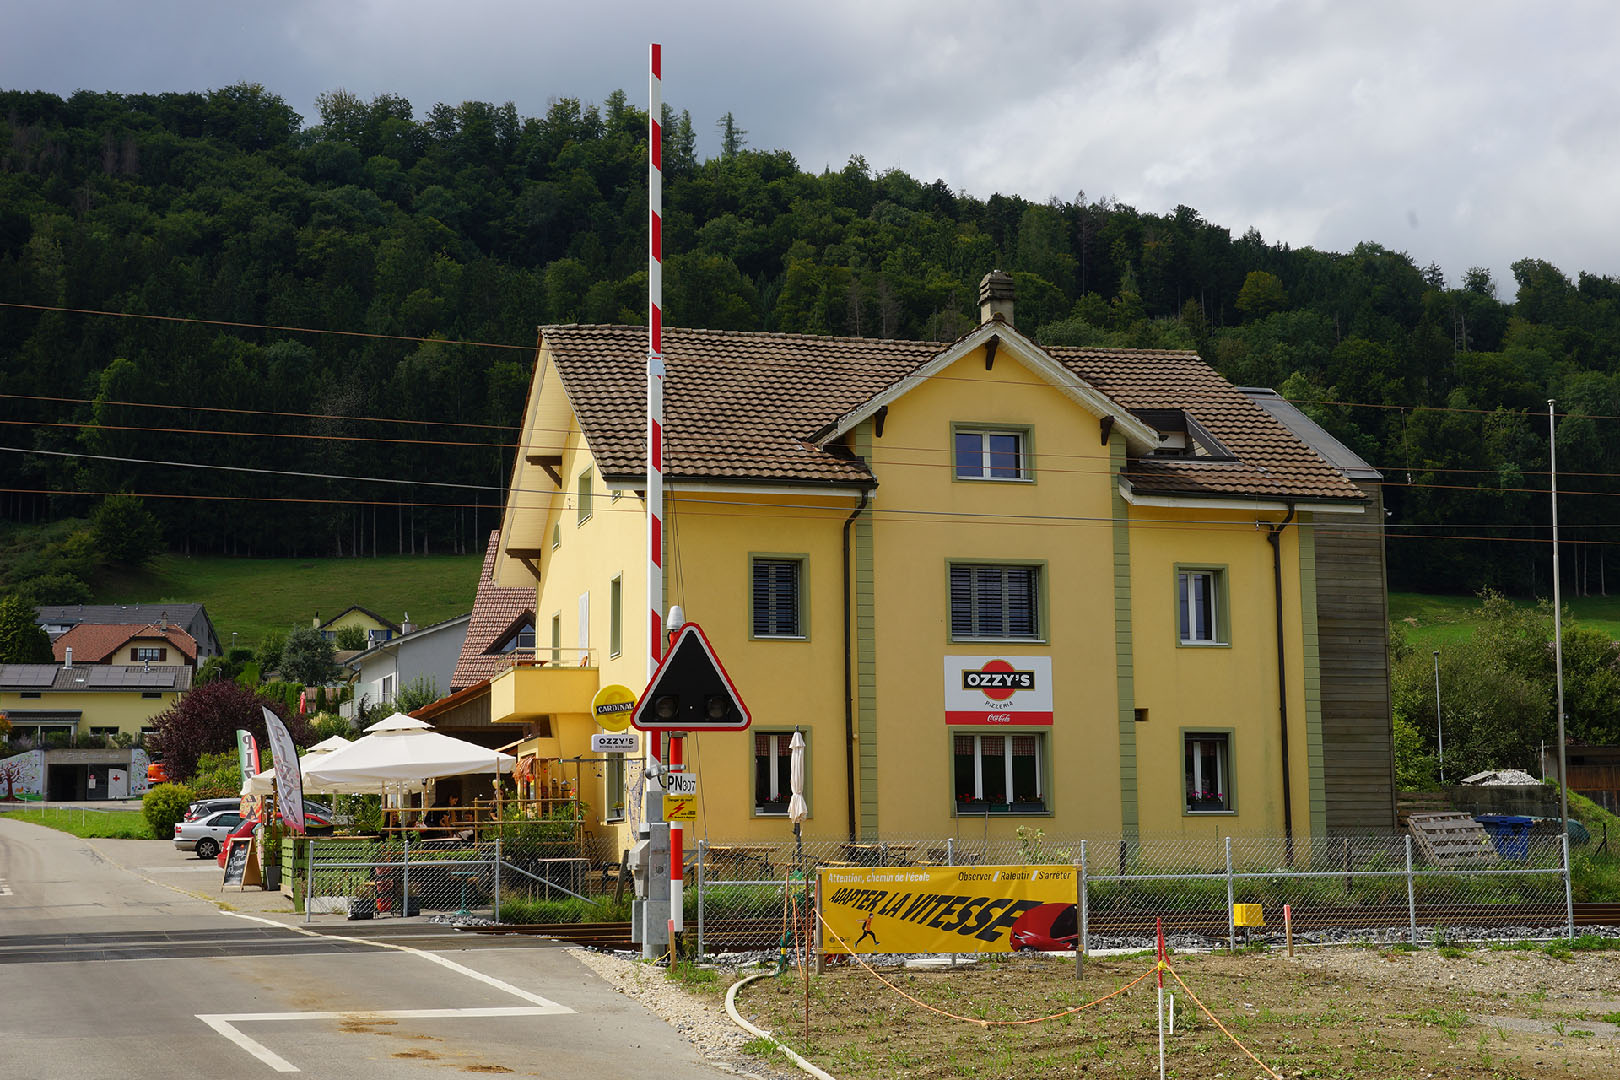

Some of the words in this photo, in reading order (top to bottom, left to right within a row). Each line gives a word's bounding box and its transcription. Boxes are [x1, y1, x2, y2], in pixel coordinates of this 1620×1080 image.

[967, 673, 1031, 687] OZZY'S
[598, 703, 634, 713] CARDINAL
[598, 737, 634, 745] OZZY'S
[273, 725, 299, 823] PIZZA
[828, 872, 865, 884] Attention,
[866, 872, 894, 883] chemin
[894, 872, 904, 882] de
[905, 871, 930, 882] l'école
[957, 871, 992, 882] Observer
[1000, 871, 1030, 881] Ralentir
[828, 887, 889, 913] ADAPTER
[877, 891, 912, 918] LA
[899, 894, 1045, 943] VITESSE
